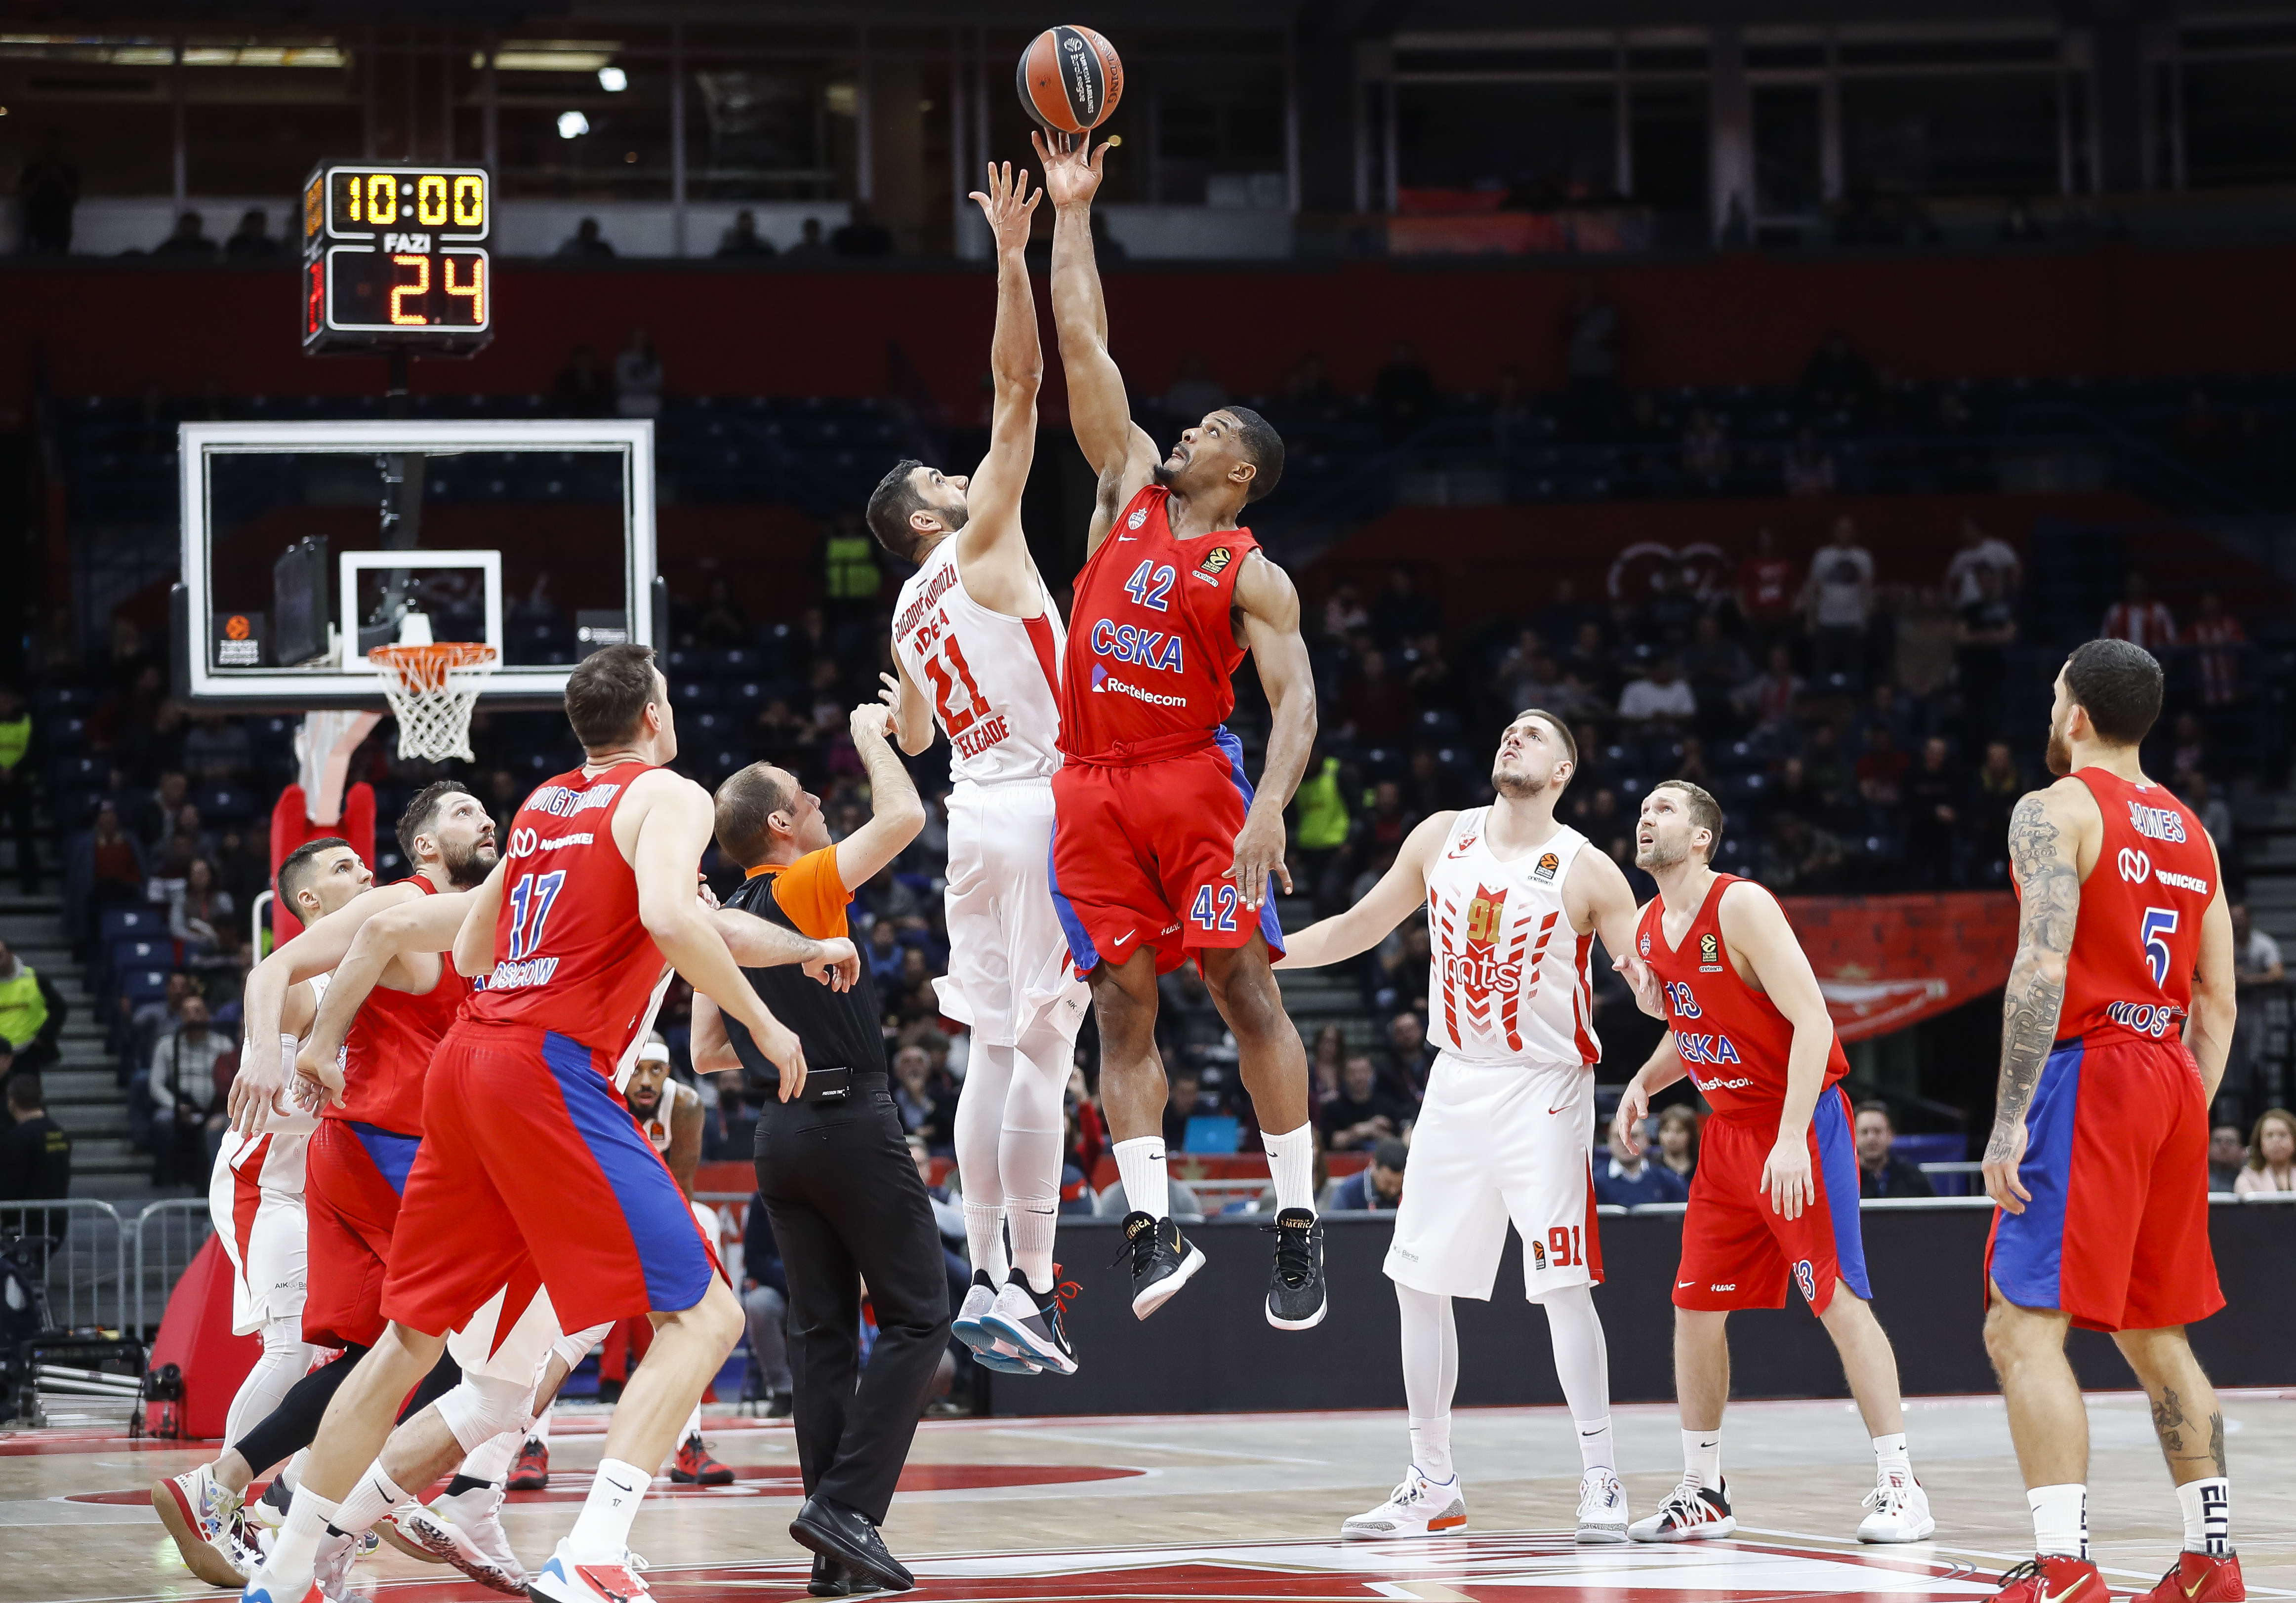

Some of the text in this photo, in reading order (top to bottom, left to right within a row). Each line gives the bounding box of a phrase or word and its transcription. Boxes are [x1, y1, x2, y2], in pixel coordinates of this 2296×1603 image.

[350, 175, 483, 226] 10:00
[384, 233, 431, 253] FAZI
[391, 255, 484, 324] 24
[1124, 559, 1176, 612] 42
[1091, 618, 1184, 674] CSKA
[924, 633, 992, 739] 21
[1107, 678, 1186, 708] Rostelecom
[2127, 801, 2186, 843] JAMES
[508, 870, 567, 961] 17
[1190, 884, 1238, 931] 42
[1467, 897, 1504, 944] 91
[1443, 951, 1520, 993] mts
[2141, 907, 2179, 990] 5
[1666, 981, 1702, 1019] 13
[1281, 1220, 1310, 1229] AMERIC
[1548, 1225, 1583, 1267] 91
[612, 1498, 622, 1507] 17
